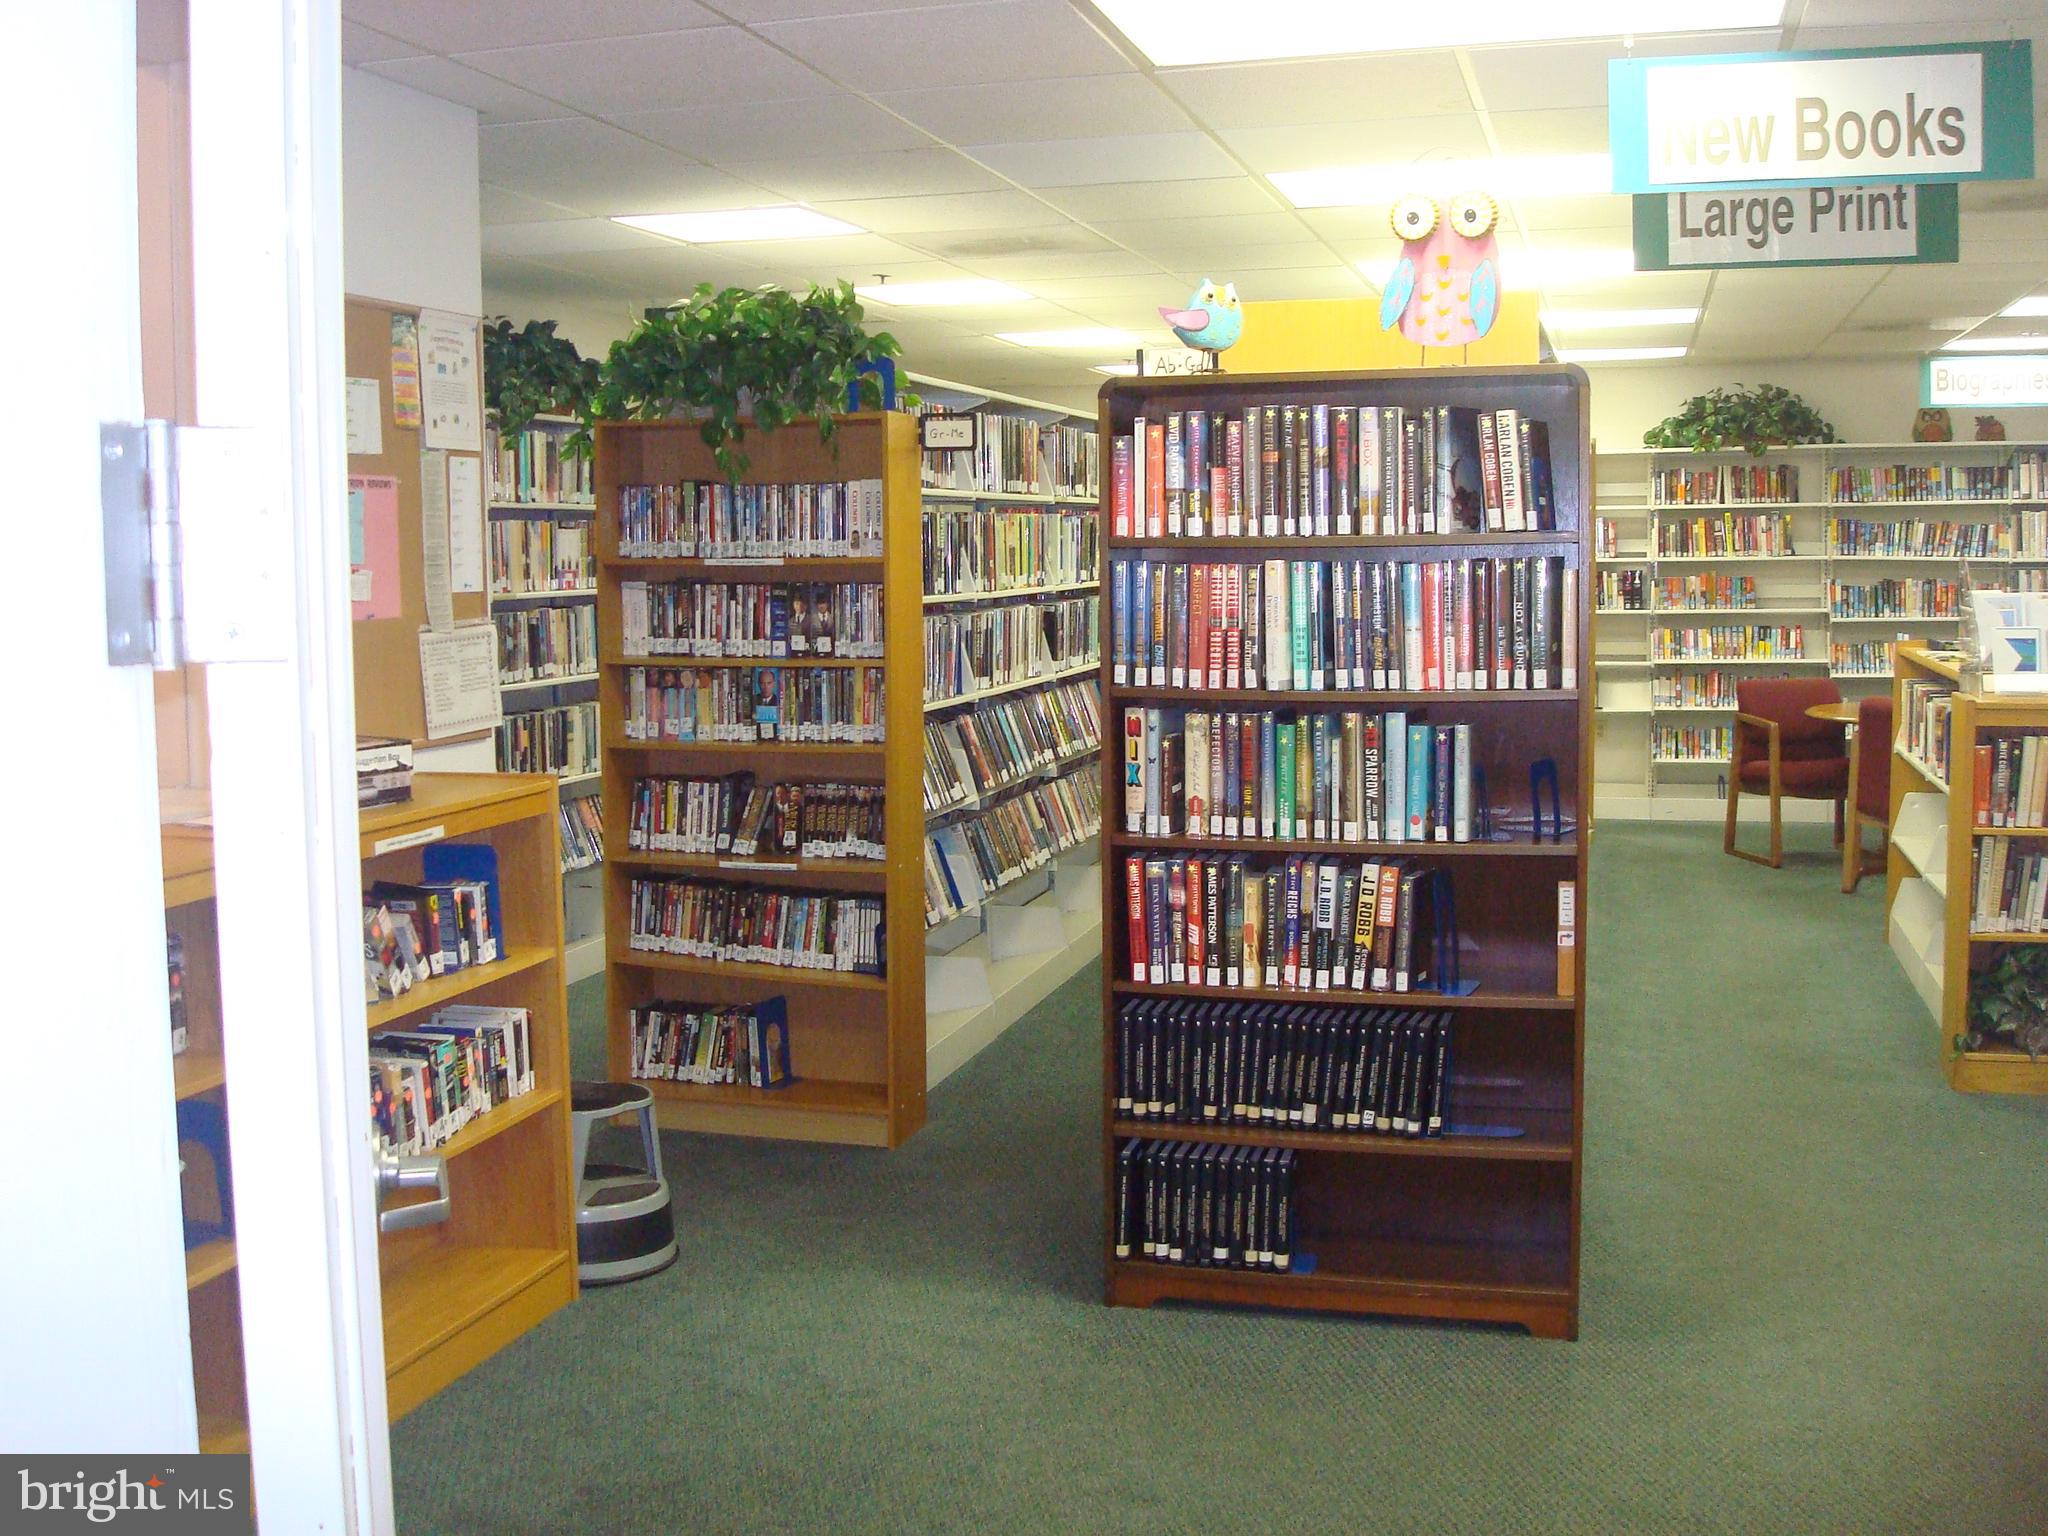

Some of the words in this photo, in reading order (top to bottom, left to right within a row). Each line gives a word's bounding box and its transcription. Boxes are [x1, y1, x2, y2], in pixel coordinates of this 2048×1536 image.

[1795, 93, 1965, 162] Books
[1679, 189, 1794, 250] Large
[1809, 185, 1908, 233] Print
[1285, 435, 1292, 448] ME
[1482, 416, 1493, 450] HARLAN
[1498, 415, 1513, 458] HARLAN
[1364, 440, 1372, 466] BOX
[1484, 452, 1496, 481] COBEN
[1502, 461, 1515, 497] COBEN
[1516, 602, 1524, 624] NOT
[1516, 625, 1524, 633] A
[1210, 631, 1221, 668] CRICHTO
[1228, 631, 1239, 668] CRICHTO
[1515, 636, 1524, 671] SOUND
[1211, 722, 1221, 777] DEFECTORS
[1365, 748, 1378, 798] SPARROW
[1208, 871, 1217, 894] AMES
[1319, 886, 1331, 896] D.
[1320, 875, 1332, 884] J.
[1381, 886, 1393, 895] D.
[1287, 890, 1298, 919] REICHS
[1318, 897, 1331, 923] ROBB
[1342, 888, 1352, 907] NORA
[1379, 896, 1393, 923] ROBB
[1208, 895, 1217, 944] PATTERSON
[1341, 907, 1351, 935] ROBERTS
[1357, 901, 1373, 936] ROBB
[1355, 945, 1361, 953] IN
